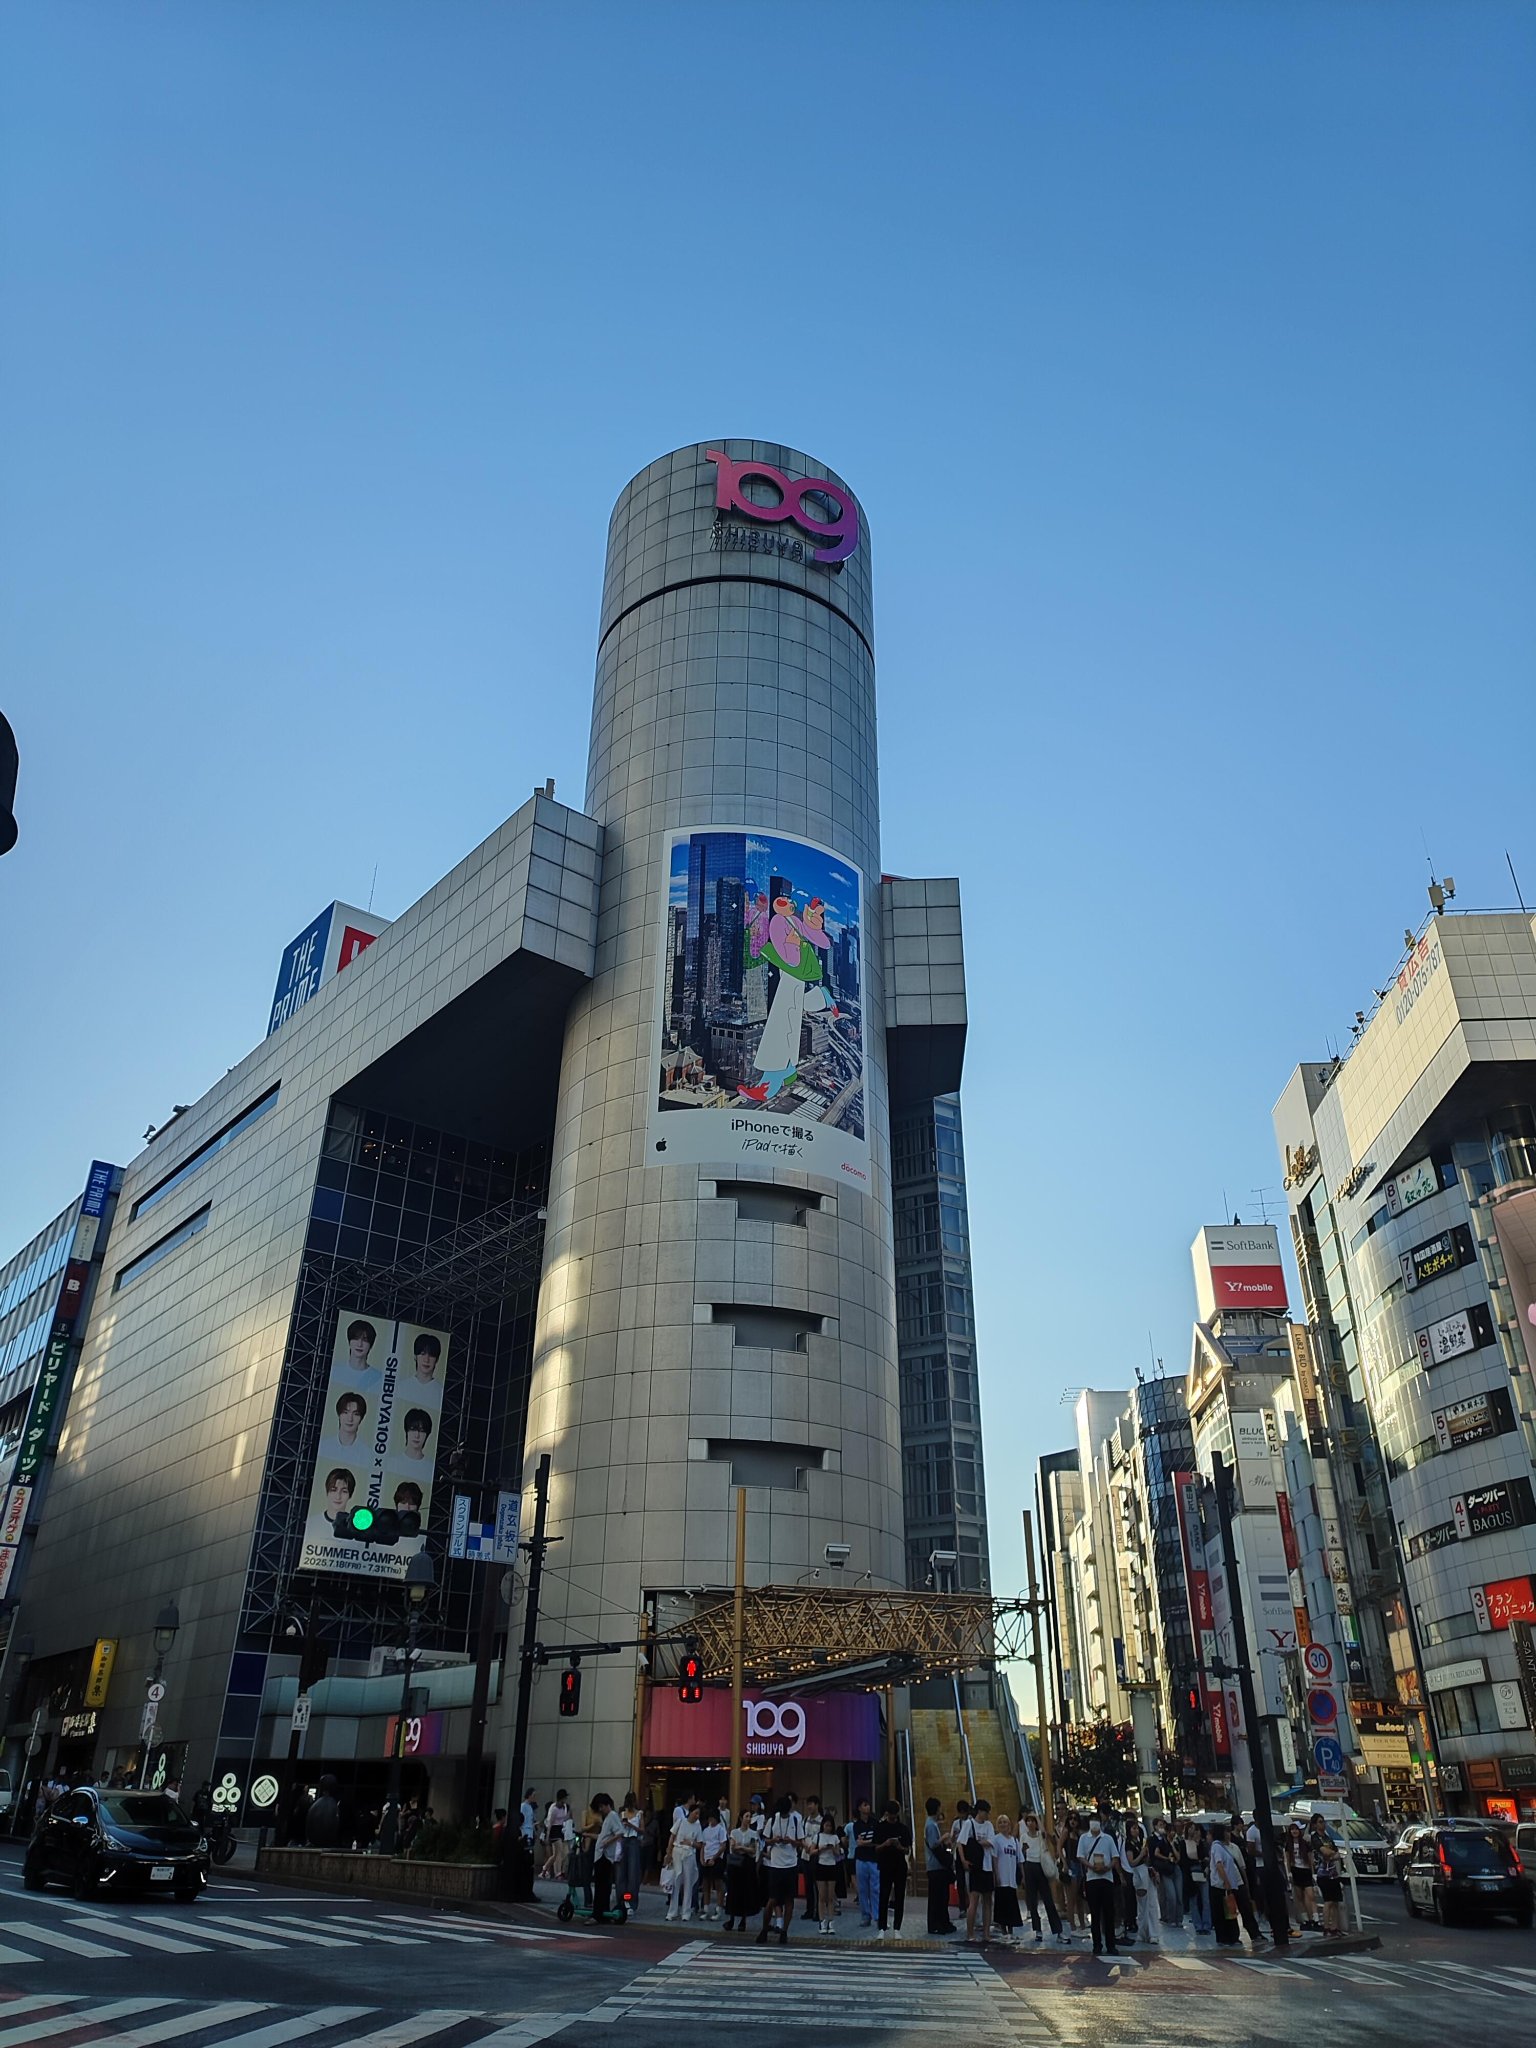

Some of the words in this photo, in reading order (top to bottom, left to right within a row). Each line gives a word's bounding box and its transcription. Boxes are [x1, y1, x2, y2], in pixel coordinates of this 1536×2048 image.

[706, 449, 858, 563] 109
[712, 521, 803, 553] SHIBUYA
[288, 930, 319, 989] THE
[1396, 941, 1440, 1025] 0120-075-787
[731, 1118, 814, 1141] iPhoneで撮る
[741, 1139, 803, 1158] iPadで描く
[92, 1169, 109, 1186] THE
[840, 1163, 867, 1181] docomo
[84, 1184, 105, 1214] PRIME
[1226, 1240, 1274, 1250] SoftBank
[22, 1341, 66, 1471] ビリヤード・ダーツ
[374, 1356, 398, 1455] SHIBUYA109
[18, 1474, 31, 1484] 3F
[1467, 1488, 1506, 1509] ダーツバー
[503, 1499, 519, 1558] 道玄坂下
[1472, 1510, 1513, 1532] BAGUS
[306, 1544, 360, 1561] SUMMER
[1262, 1607, 1293, 1616] SoftBan
[1495, 1600, 1535, 1618] クリニック
[1310, 1652, 1327, 1668] 30
[1523, 1640, 1536, 1670] SAINT
[151, 1687, 160, 1698] 4
[742, 1700, 806, 1755] 109
[746, 1742, 784, 1755] SHIBUYA
[1321, 1746, 1334, 1769] P
